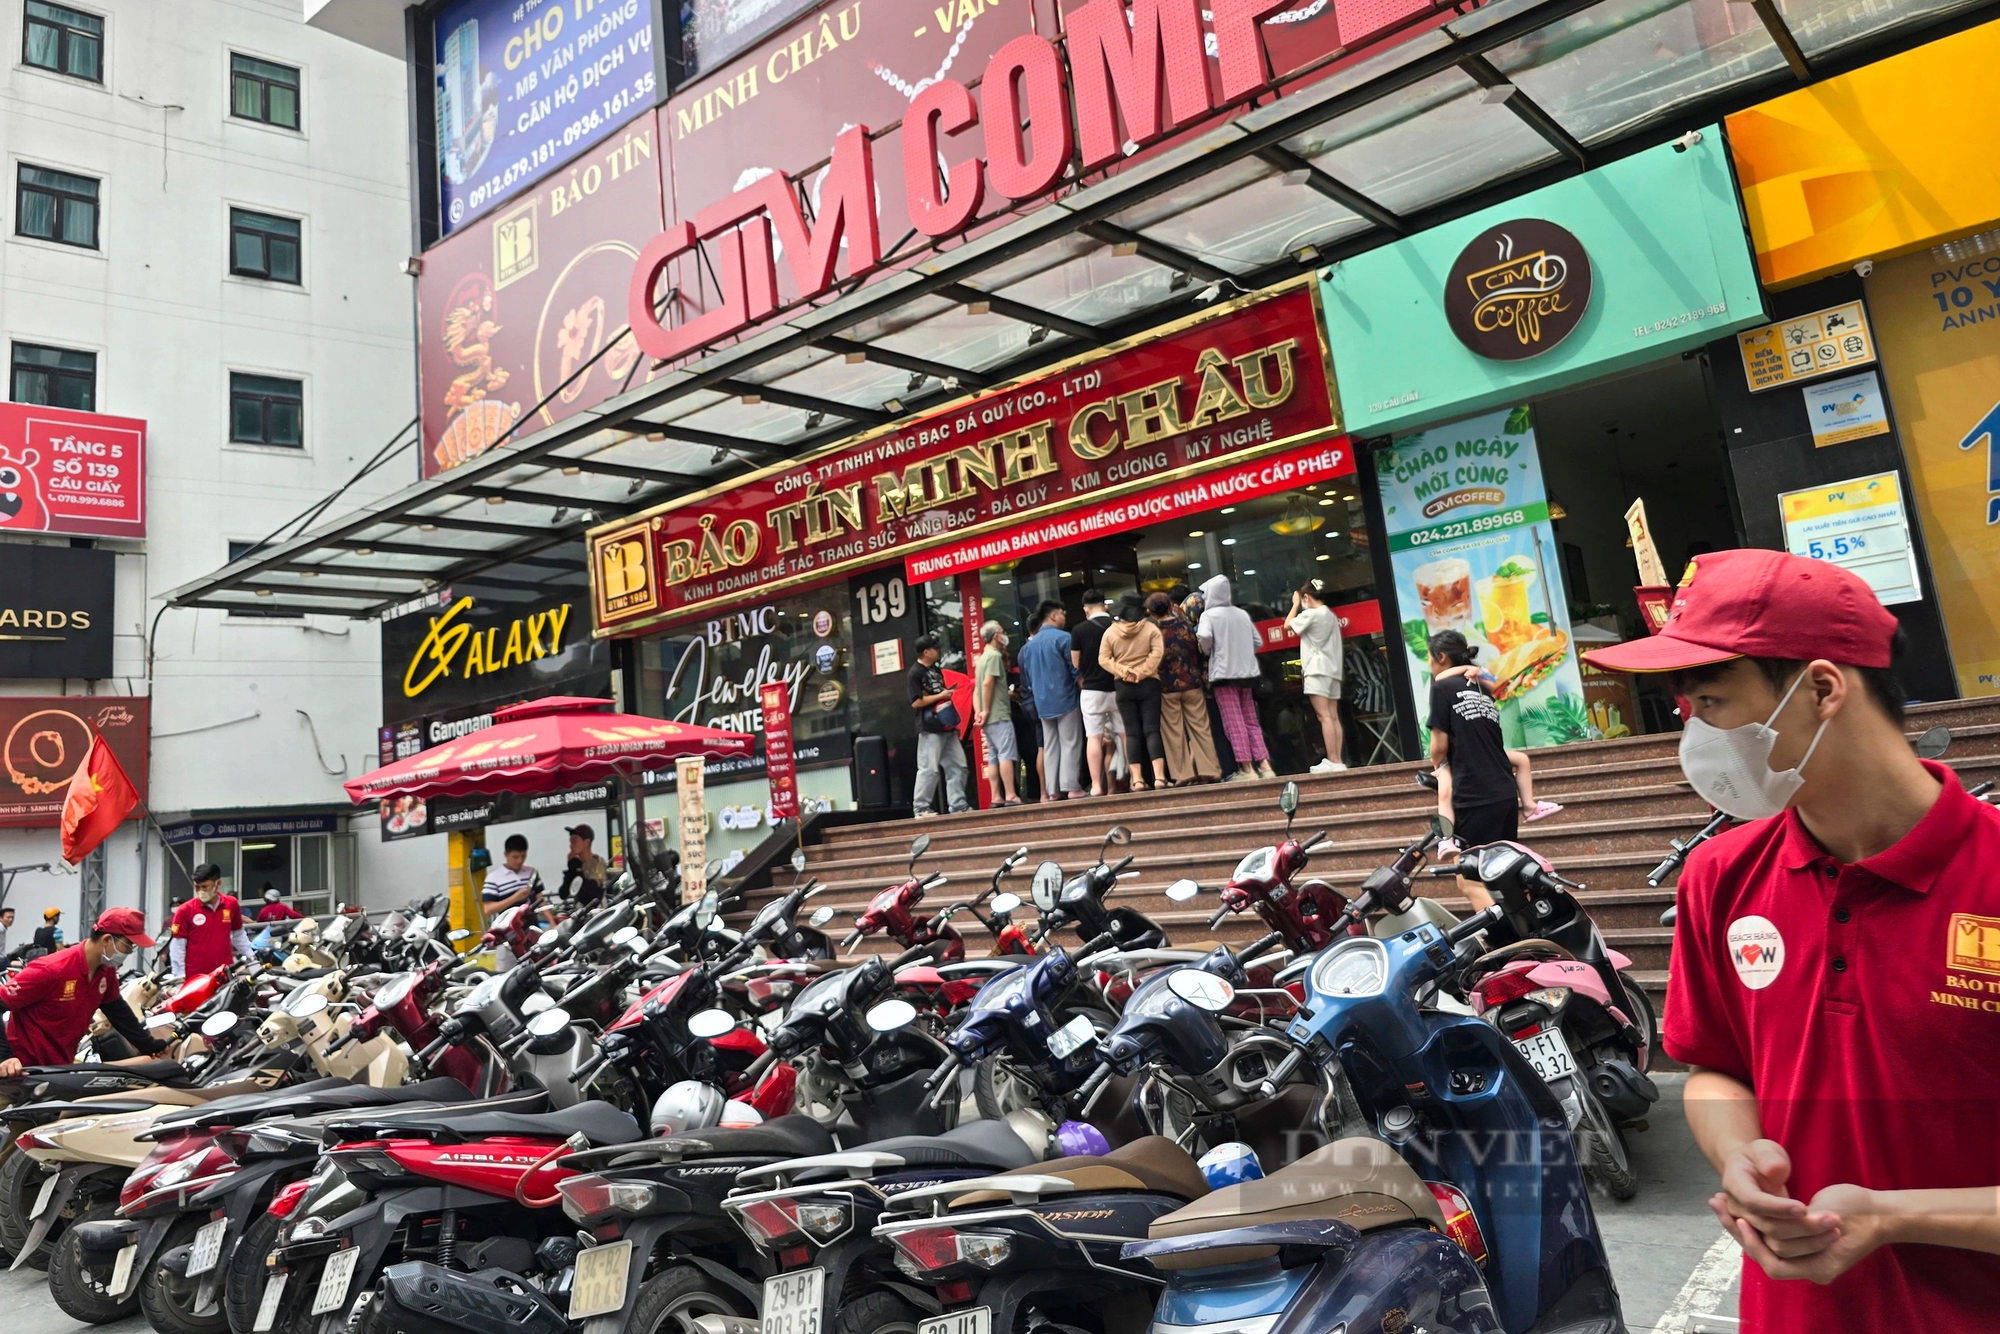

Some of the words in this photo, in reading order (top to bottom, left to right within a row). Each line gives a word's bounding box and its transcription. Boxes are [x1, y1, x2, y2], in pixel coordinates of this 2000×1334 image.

[504, 5, 564, 71] CHO
[515, 71, 538, 100] MB
[541, 43, 575, 80] VĂN
[577, 0, 639, 55] PHÒNG
[517, 99, 551, 134] CĂN
[554, 74, 580, 110] HỘ
[582, 50, 624, 89] DỊCH
[627, 24, 652, 53] VỤ
[676, 64, 761, 141] MINH
[765, 2, 862, 84] CHÂU
[549, 164, 602, 217] BẢO
[605, 130, 652, 182] TÍN
[1933, 286, 1973, 312] 10
[1474, 293, 1575, 345] Coffee
[1632, 325, 1654, 338] TEL:
[1654, 316, 1679, 332] 0242
[1680, 308, 1705, 324] 2189
[1706, 302, 1727, 316] 968
[1750, 358, 1766, 369] THU
[1766, 355, 1782, 367] TIỀN
[1754, 348, 1773, 360] ĐIỂM
[1755, 374, 1773, 386] DỊCH
[1774, 372, 1785, 382] VỤ
[49, 435, 107, 457] TẦNG
[110, 444, 123, 459] 5
[773, 469, 812, 496] CÔNG
[816, 460, 834, 480] TY
[834, 449, 875, 475] TNHH
[876, 431, 917, 460] VÀNG
[919, 422, 950, 447] BẠC
[955, 410, 978, 434] ĐÁ
[981, 395, 1016, 424] QUÝ
[1061, 369, 1101, 398] LTD)
[52, 457, 83, 475] SỐ
[86, 462, 119, 479] 139
[661, 512, 764, 588] BẢO
[766, 480, 867, 555] TÍN
[871, 418, 1058, 524] MINH
[1067, 338, 1300, 461] CHÂU
[1394, 445, 1449, 484] CHÀO
[1454, 434, 1520, 460] NGÀY
[49, 475, 83, 491] CẦU
[85, 480, 122, 494] GIẤY
[1413, 470, 1451, 502] MỚI
[1454, 461, 1510, 486] CÙNG
[684, 579, 713, 603] KINH
[715, 567, 760, 594] DOANH
[761, 556, 786, 580] CHẾ
[789, 551, 815, 573] TÁC
[817, 540, 865, 566] TRANG
[867, 528, 898, 550] SỨC
[904, 517, 943, 542] VÀNG
[946, 506, 977, 531] BẠC
[991, 492, 1013, 515] ĐÁ
[1015, 482, 1049, 509] QUÝ
[1070, 471, 1101, 493] KIM
[1106, 451, 1168, 482] CƯƠNG
[1185, 438, 1212, 461] MỸ
[1220, 418, 1274, 451] NGHỆ
[911, 554, 954, 577] TRUNG
[953, 546, 981, 567] TÂM
[981, 539, 1011, 557] MUA
[1011, 529, 1040, 550] BÁN
[1040, 516, 1080, 543] VÀNG
[1080, 503, 1127, 533] MIẾNG
[1127, 493, 1172, 521] ĐƯỢC
[1173, 482, 1209, 509] NHÀ
[1210, 471, 1259, 501] NƯỚC
[1260, 459, 1295, 485] CẤP
[1298, 448, 1344, 476] PHÉP
[1410, 510, 1525, 546] 024.221.89968
[608, 596, 628, 611] BTMC
[855, 577, 907, 626] 139
[707, 604, 777, 649] BTMC
[971, 618, 981, 651] BTMC
[403, 595, 571, 698] GALAXY
[429, 714, 493, 743] Gangnam
[641, 771, 655, 785] 10
[773, 791, 791, 803] 139
[1929, 991, 1979, 1011] MINH
[1946, 974, 1984, 993] BẢO
[677, 1165, 746, 1178] VISION
[772, 1273, 814, 1312] 29-B1
